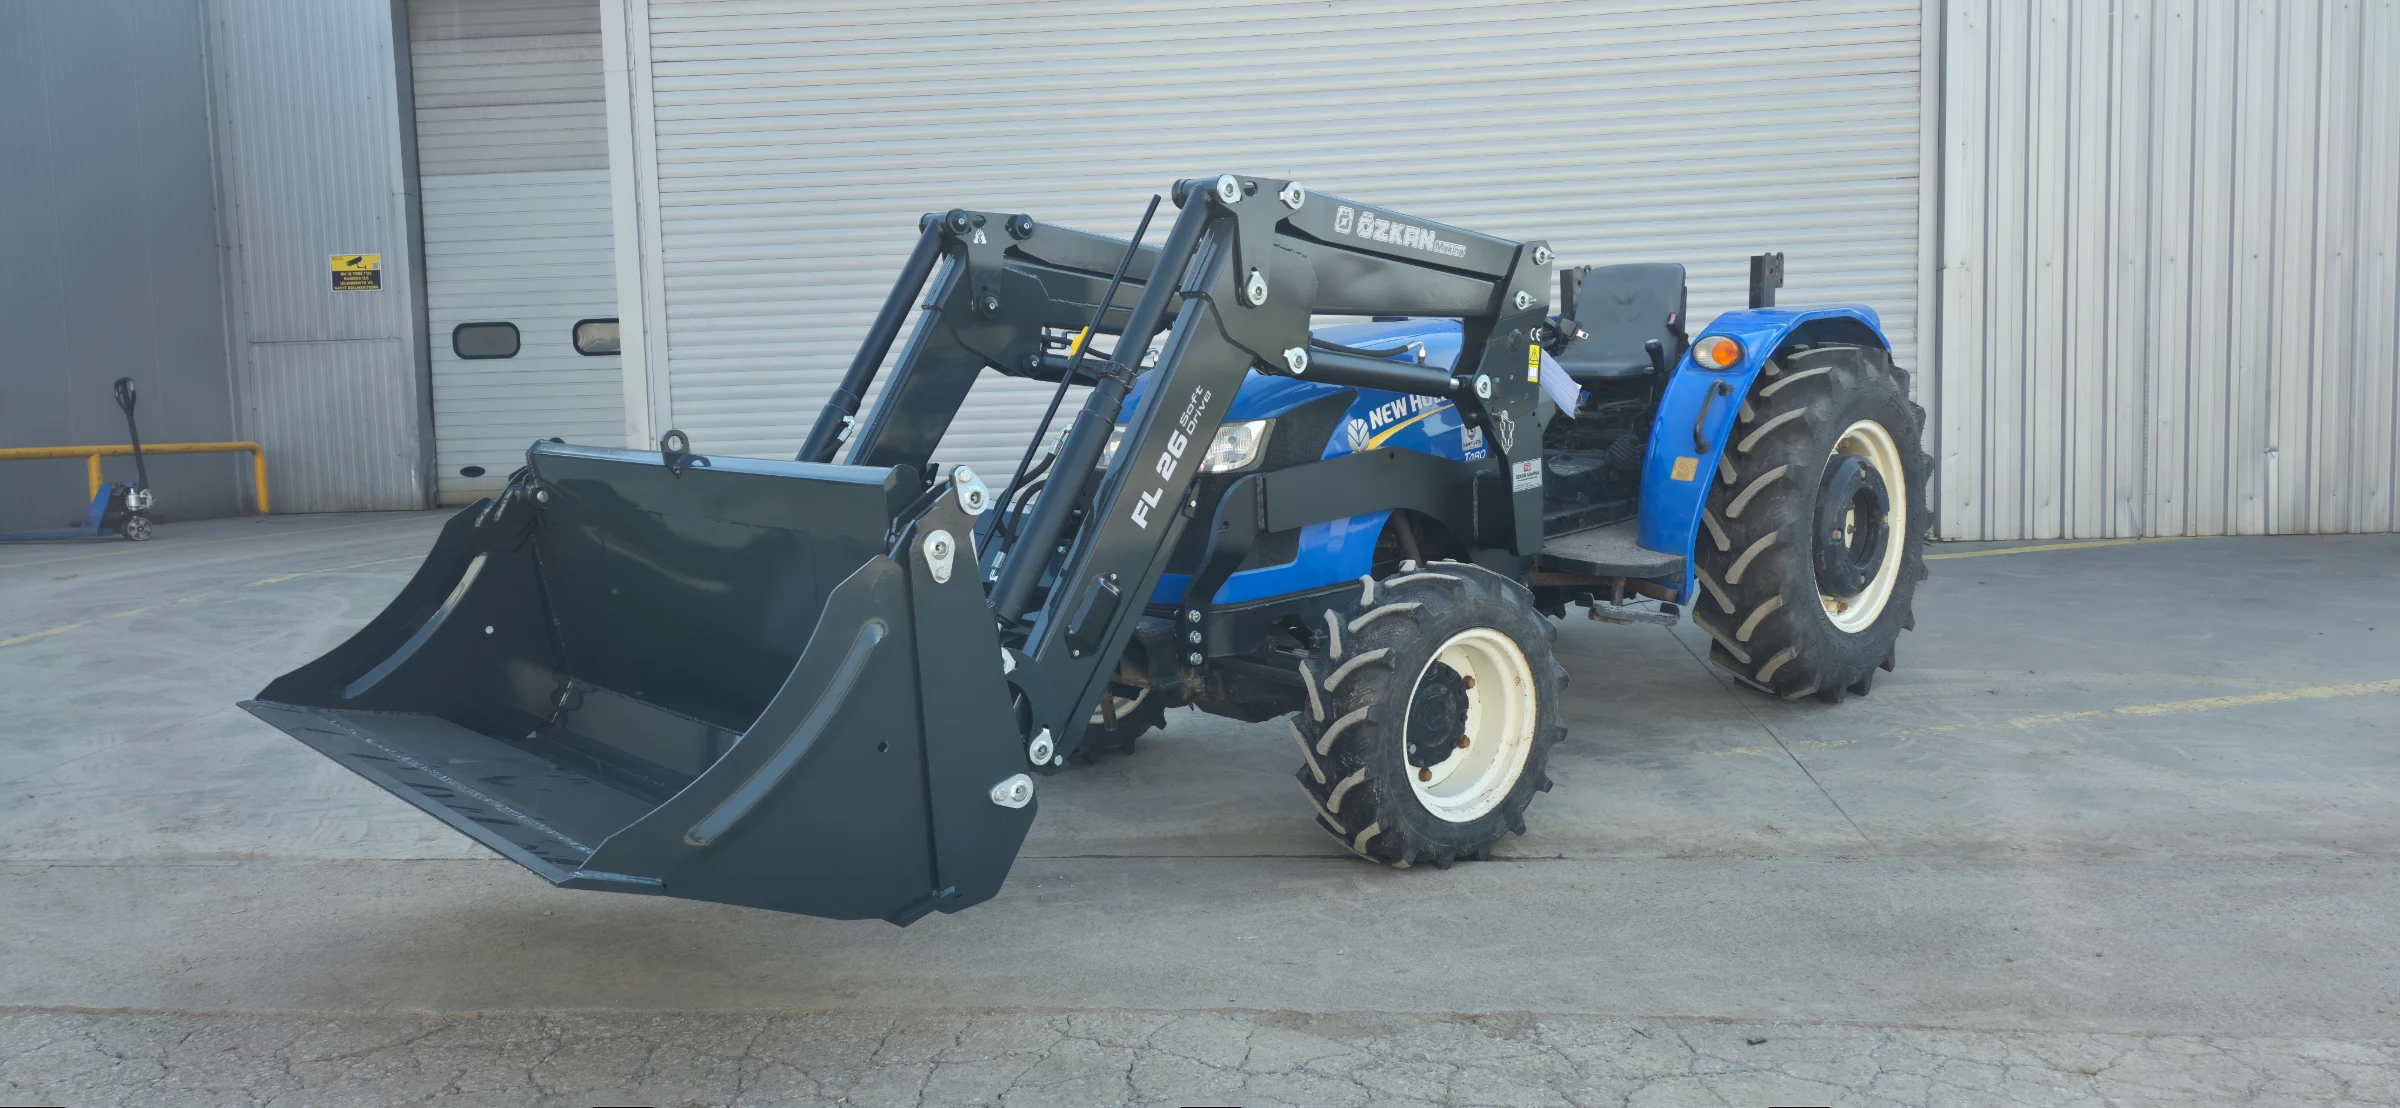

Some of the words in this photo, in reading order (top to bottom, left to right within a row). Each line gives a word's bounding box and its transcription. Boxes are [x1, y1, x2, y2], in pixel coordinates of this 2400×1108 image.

[1357, 211, 1436, 251] ÖZKAN
[1434, 240, 1466, 257] Makina
[1179, 385, 1204, 427] Soft
[1186, 390, 1212, 435] Drive
[1368, 397, 1408, 430] NEW
[1131, 487, 1164, 529] FL
[1155, 429, 1188, 481] 26
